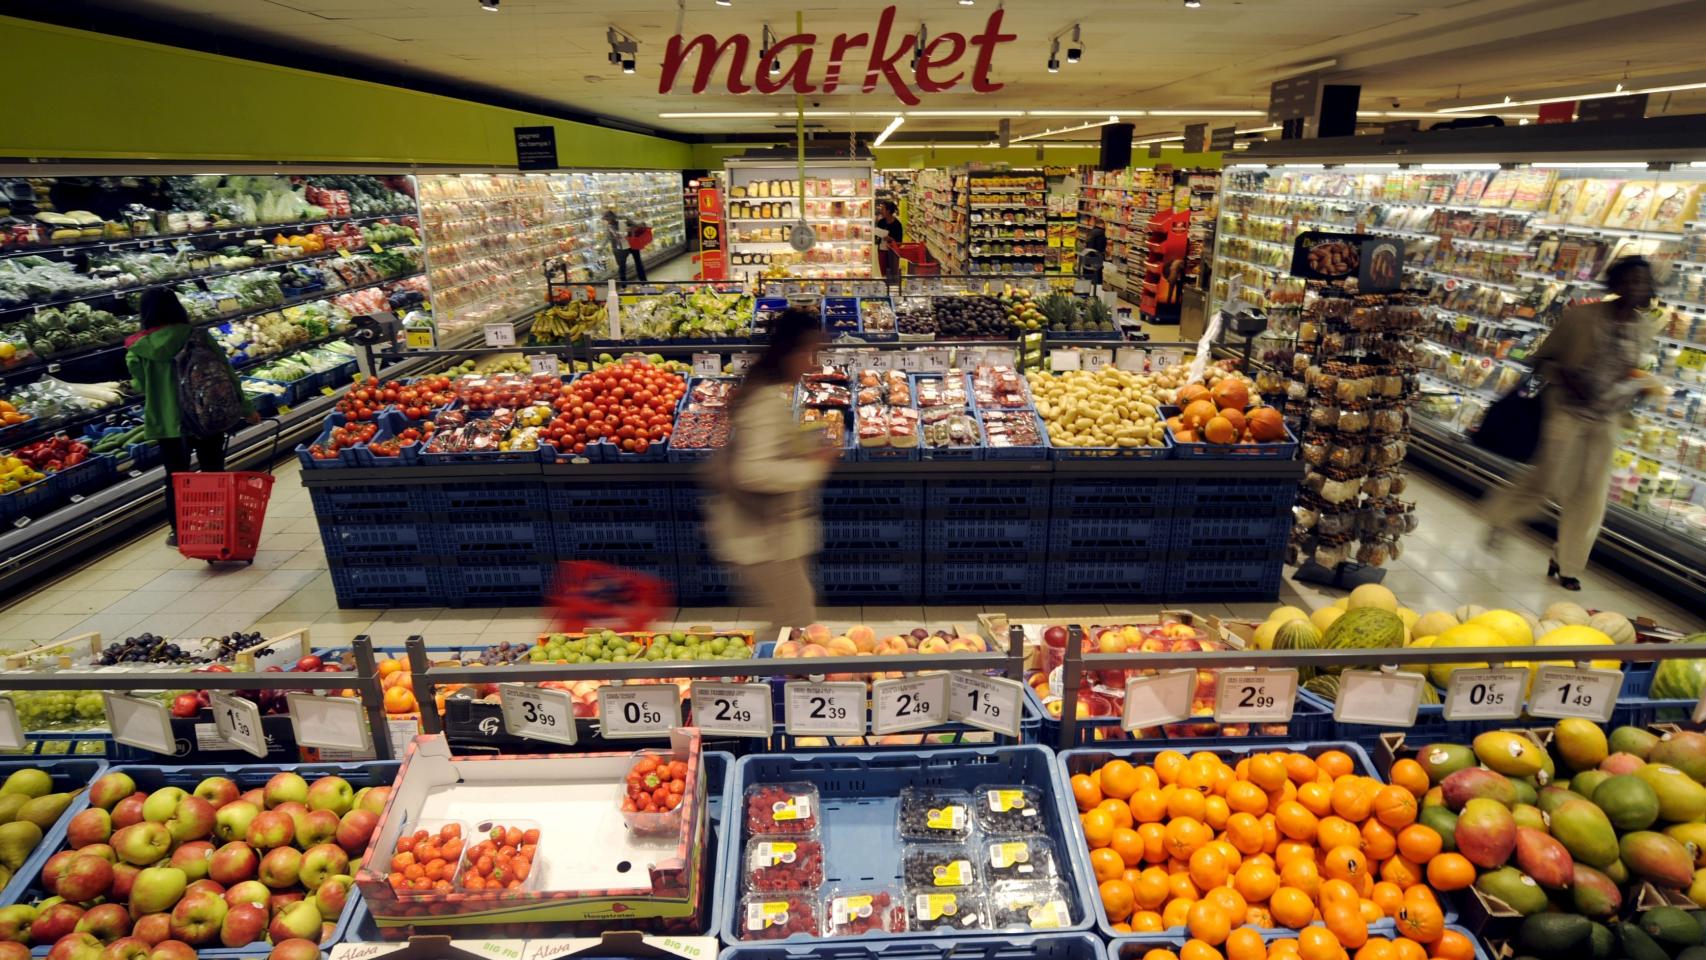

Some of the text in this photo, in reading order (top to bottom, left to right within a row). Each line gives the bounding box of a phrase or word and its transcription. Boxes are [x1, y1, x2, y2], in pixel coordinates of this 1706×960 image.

[658, 5, 1018, 106] market
[483, 942, 519, 958] BIG FIG
[664, 938, 701, 957] BIG FIG
